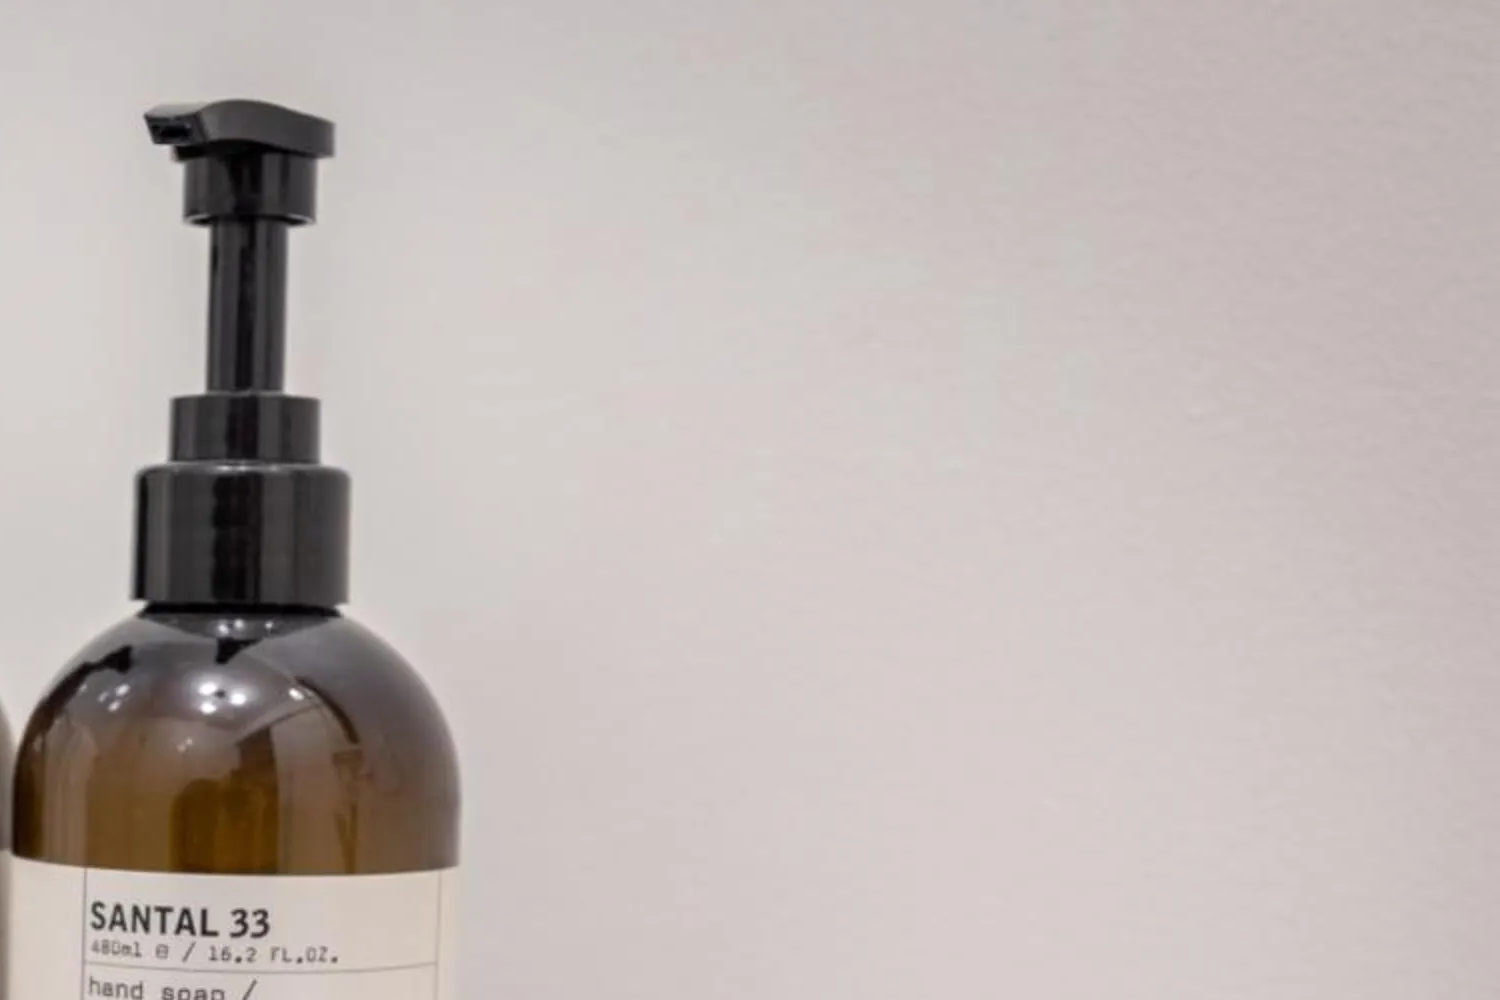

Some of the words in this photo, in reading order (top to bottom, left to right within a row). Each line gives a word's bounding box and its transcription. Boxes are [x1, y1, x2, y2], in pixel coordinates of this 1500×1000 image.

[90, 901, 219, 938] SANTAL
[229, 908, 271, 939] 33
[91, 939, 142, 959] 480ml
[207, 945, 258, 963] 16.2
[269, 946, 340, 964] FL.OZ.
[88, 976, 143, 1000] hand
